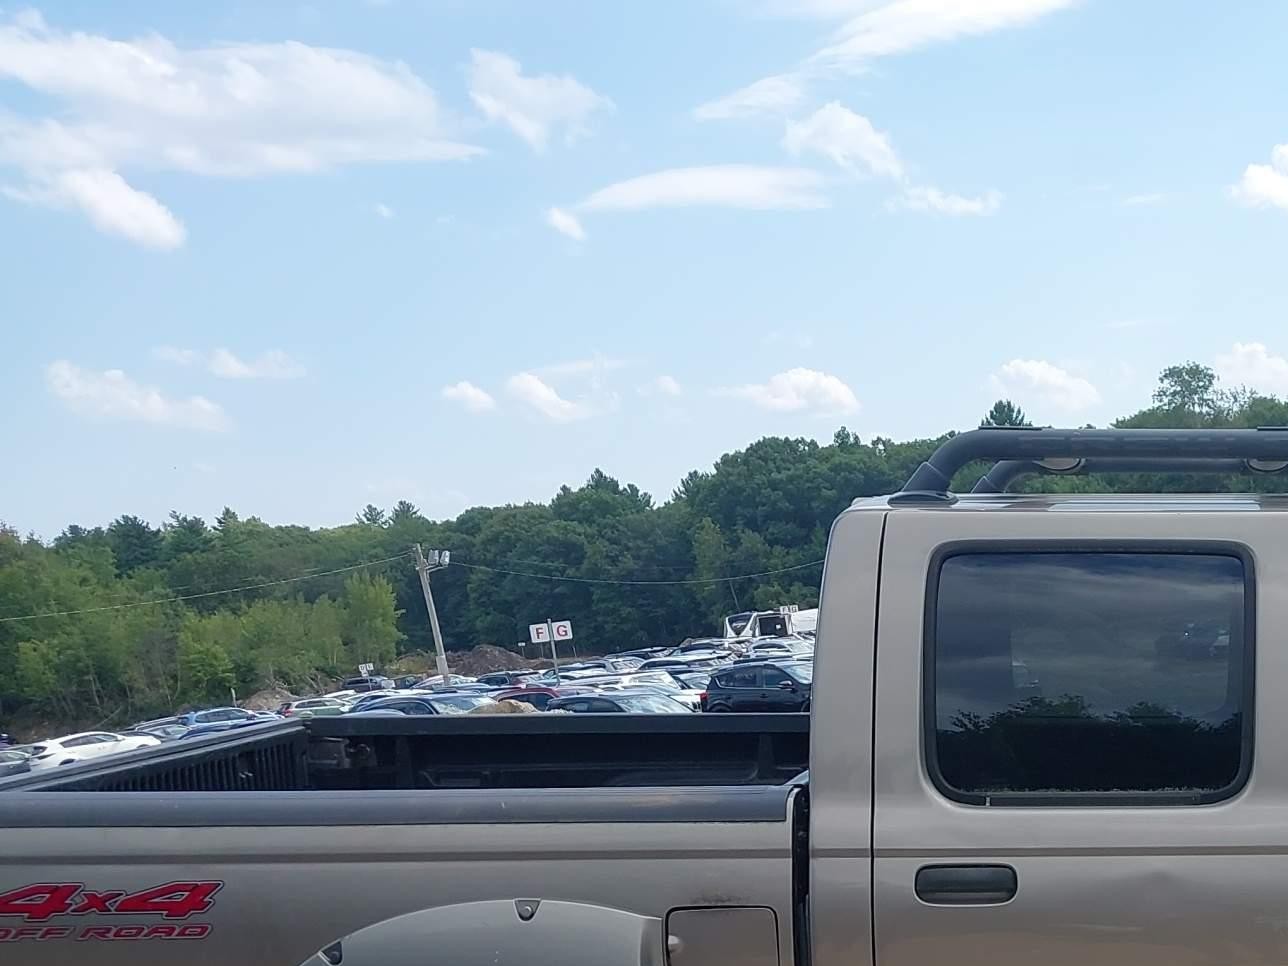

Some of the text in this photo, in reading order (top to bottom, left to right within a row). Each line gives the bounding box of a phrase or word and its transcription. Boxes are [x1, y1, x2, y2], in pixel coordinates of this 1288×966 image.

[535, 624, 568, 639] F G
[0, 880, 225, 922] 4x4
[74, 924, 214, 941] ROAD
